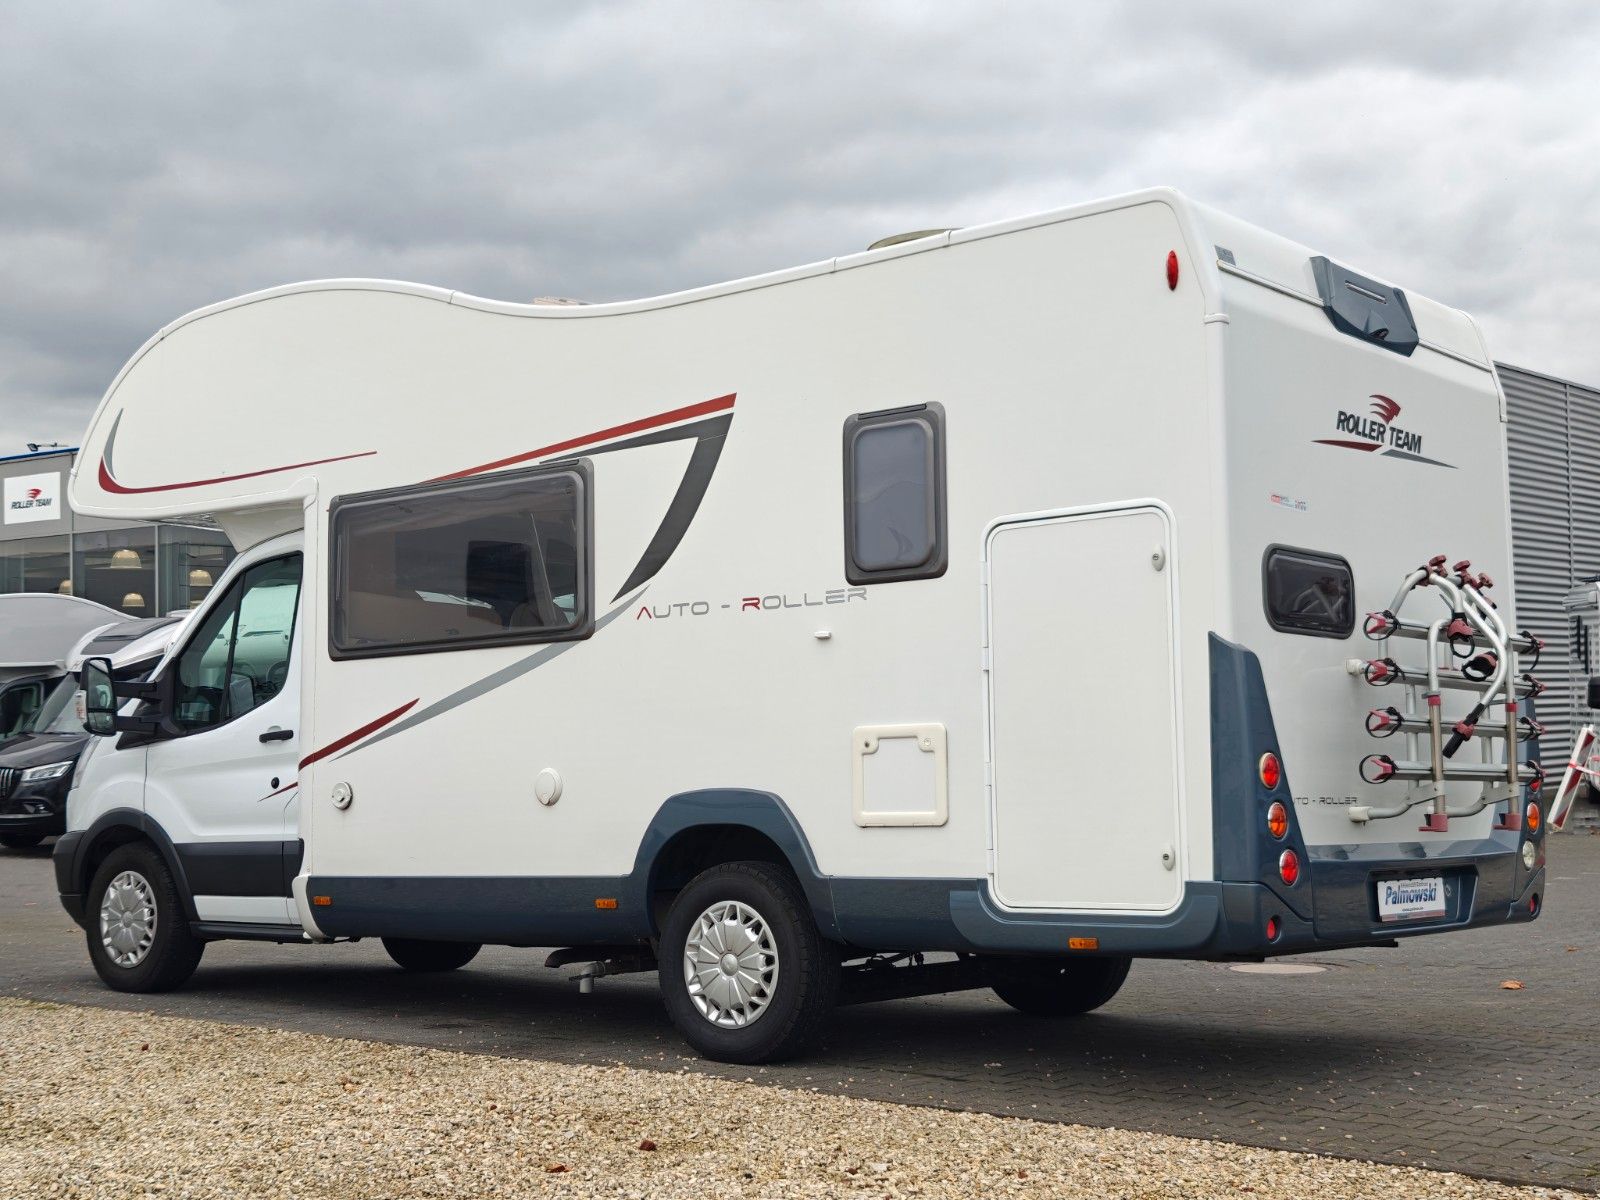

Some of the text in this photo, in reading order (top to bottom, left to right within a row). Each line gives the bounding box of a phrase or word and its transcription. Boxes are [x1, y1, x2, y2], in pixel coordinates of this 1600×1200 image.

[1336, 410, 1422, 454] ROLLER TEAM
[11, 498, 52, 509] ROLLER TEAM
[636, 601, 710, 620] AUTO
[742, 587, 868, 612] ROLLER
[1319, 796, 1358, 805] ROLLER
[1385, 883, 1437, 905] Palmowski
